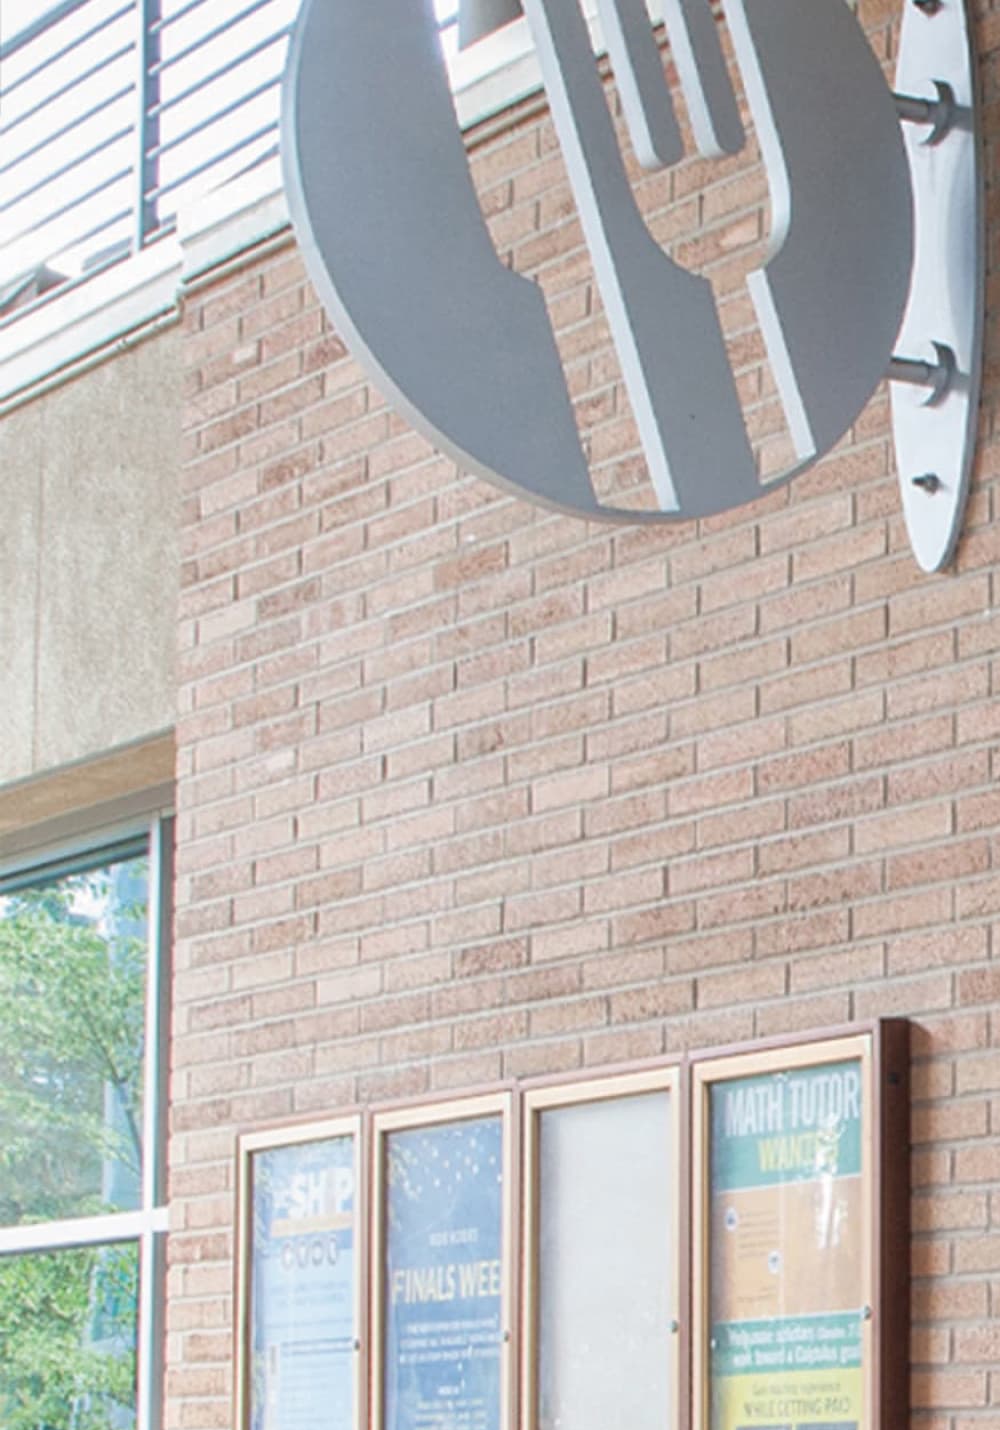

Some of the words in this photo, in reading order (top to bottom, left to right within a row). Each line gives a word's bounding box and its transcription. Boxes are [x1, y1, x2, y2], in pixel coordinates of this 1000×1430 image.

[725, 1084, 784, 1137] MATH
[788, 1070, 860, 1130] TUTOR
[391, 1264, 455, 1305] FINALS
